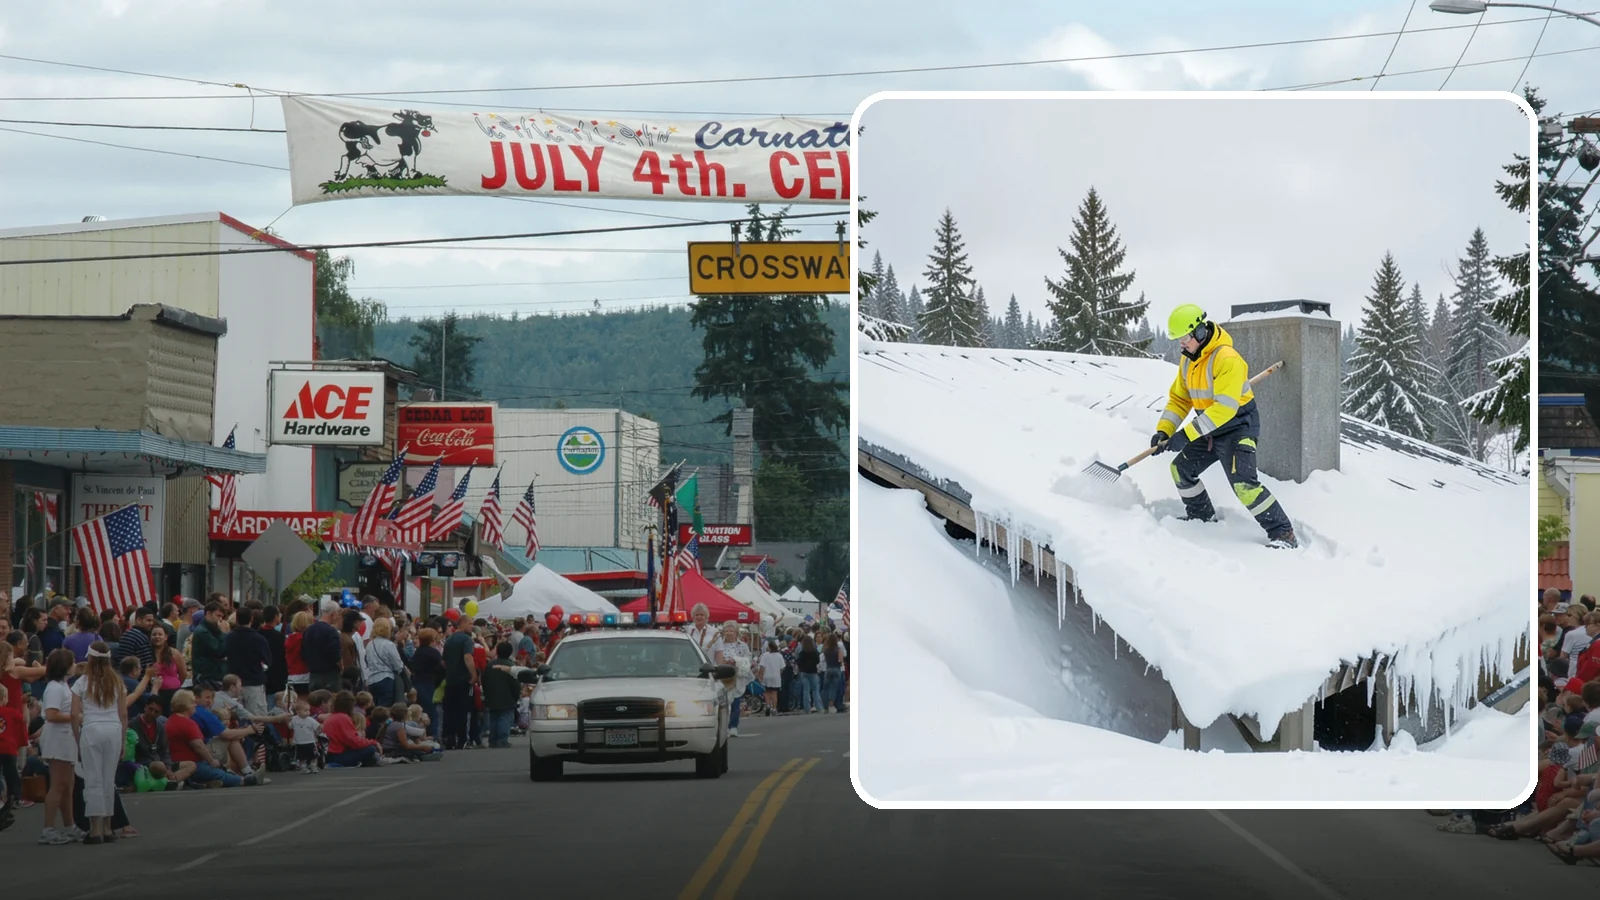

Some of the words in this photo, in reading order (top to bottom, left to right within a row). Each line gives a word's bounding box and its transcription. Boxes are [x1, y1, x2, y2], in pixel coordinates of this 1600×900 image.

[481, 140, 605, 193] JULY
[631, 150, 747, 198] 4th.
[697, 254, 850, 280] CROSSWA
[283, 380, 373, 420] ACE
[405, 409, 453, 422] CEDAR
[283, 421, 371, 437] Hardware
[416, 428, 477, 447] Coca-Cola
[95, 485, 124, 495] Vincent
[126, 485, 136, 495] de
[138, 486, 155, 495] Paul
[81, 503, 154, 522] THT
[212, 516, 331, 535] HARDARE
[688, 526, 741, 535] CRNATION
[699, 535, 730, 543] GLASS
